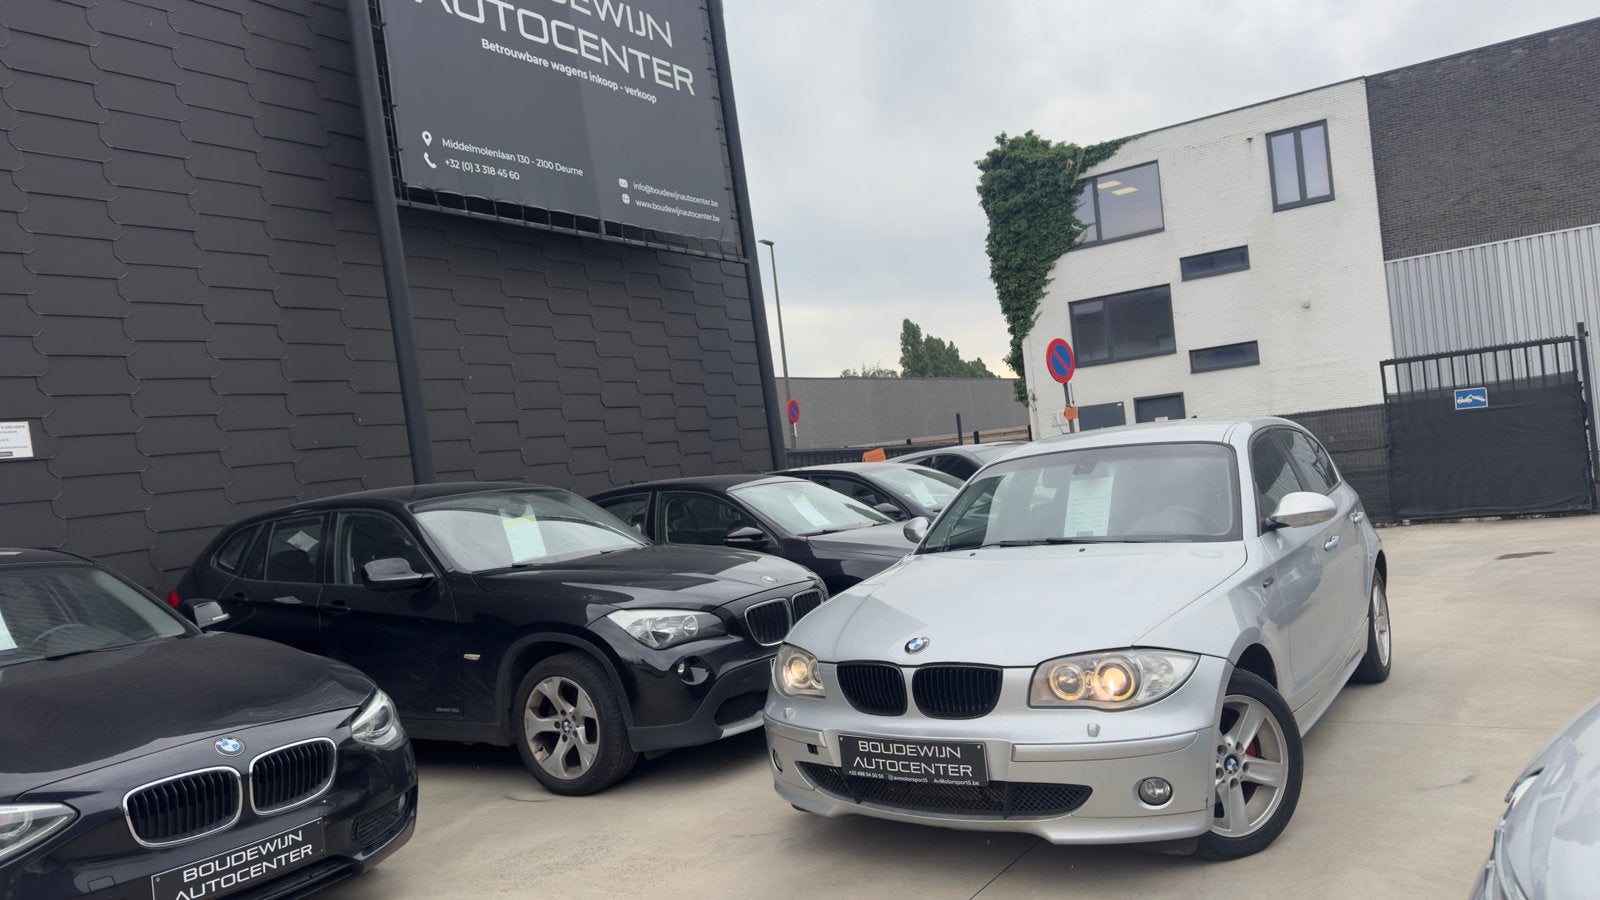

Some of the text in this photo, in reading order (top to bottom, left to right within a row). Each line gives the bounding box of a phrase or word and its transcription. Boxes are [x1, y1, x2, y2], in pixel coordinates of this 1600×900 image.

[552, 0, 673, 48] WIJN
[481, 38, 549, 68] Betrouwbare
[550, 61, 588, 80] wagens
[588, 70, 619, 92] inkoop
[624, 85, 658, 105] verkoop
[442, 138, 516, 162] Middelmolenlaan
[516, 153, 531, 165] 130
[536, 158, 555, 170] 2100
[555, 162, 584, 176] Deurne
[445, 158, 520, 181] +32 (0) 3 318 45 60
[632, 181, 719, 208] info@boudewijnautocenter.be
[634, 199, 721, 223] www.boudewijnautocenter.be
[858, 740, 961, 759] BOUDEWIJN
[853, 756, 973, 777] AUTOCENTER
[175, 844, 313, 900] AUTOCENTER
[182, 830, 303, 883] BOUDEWIJN
